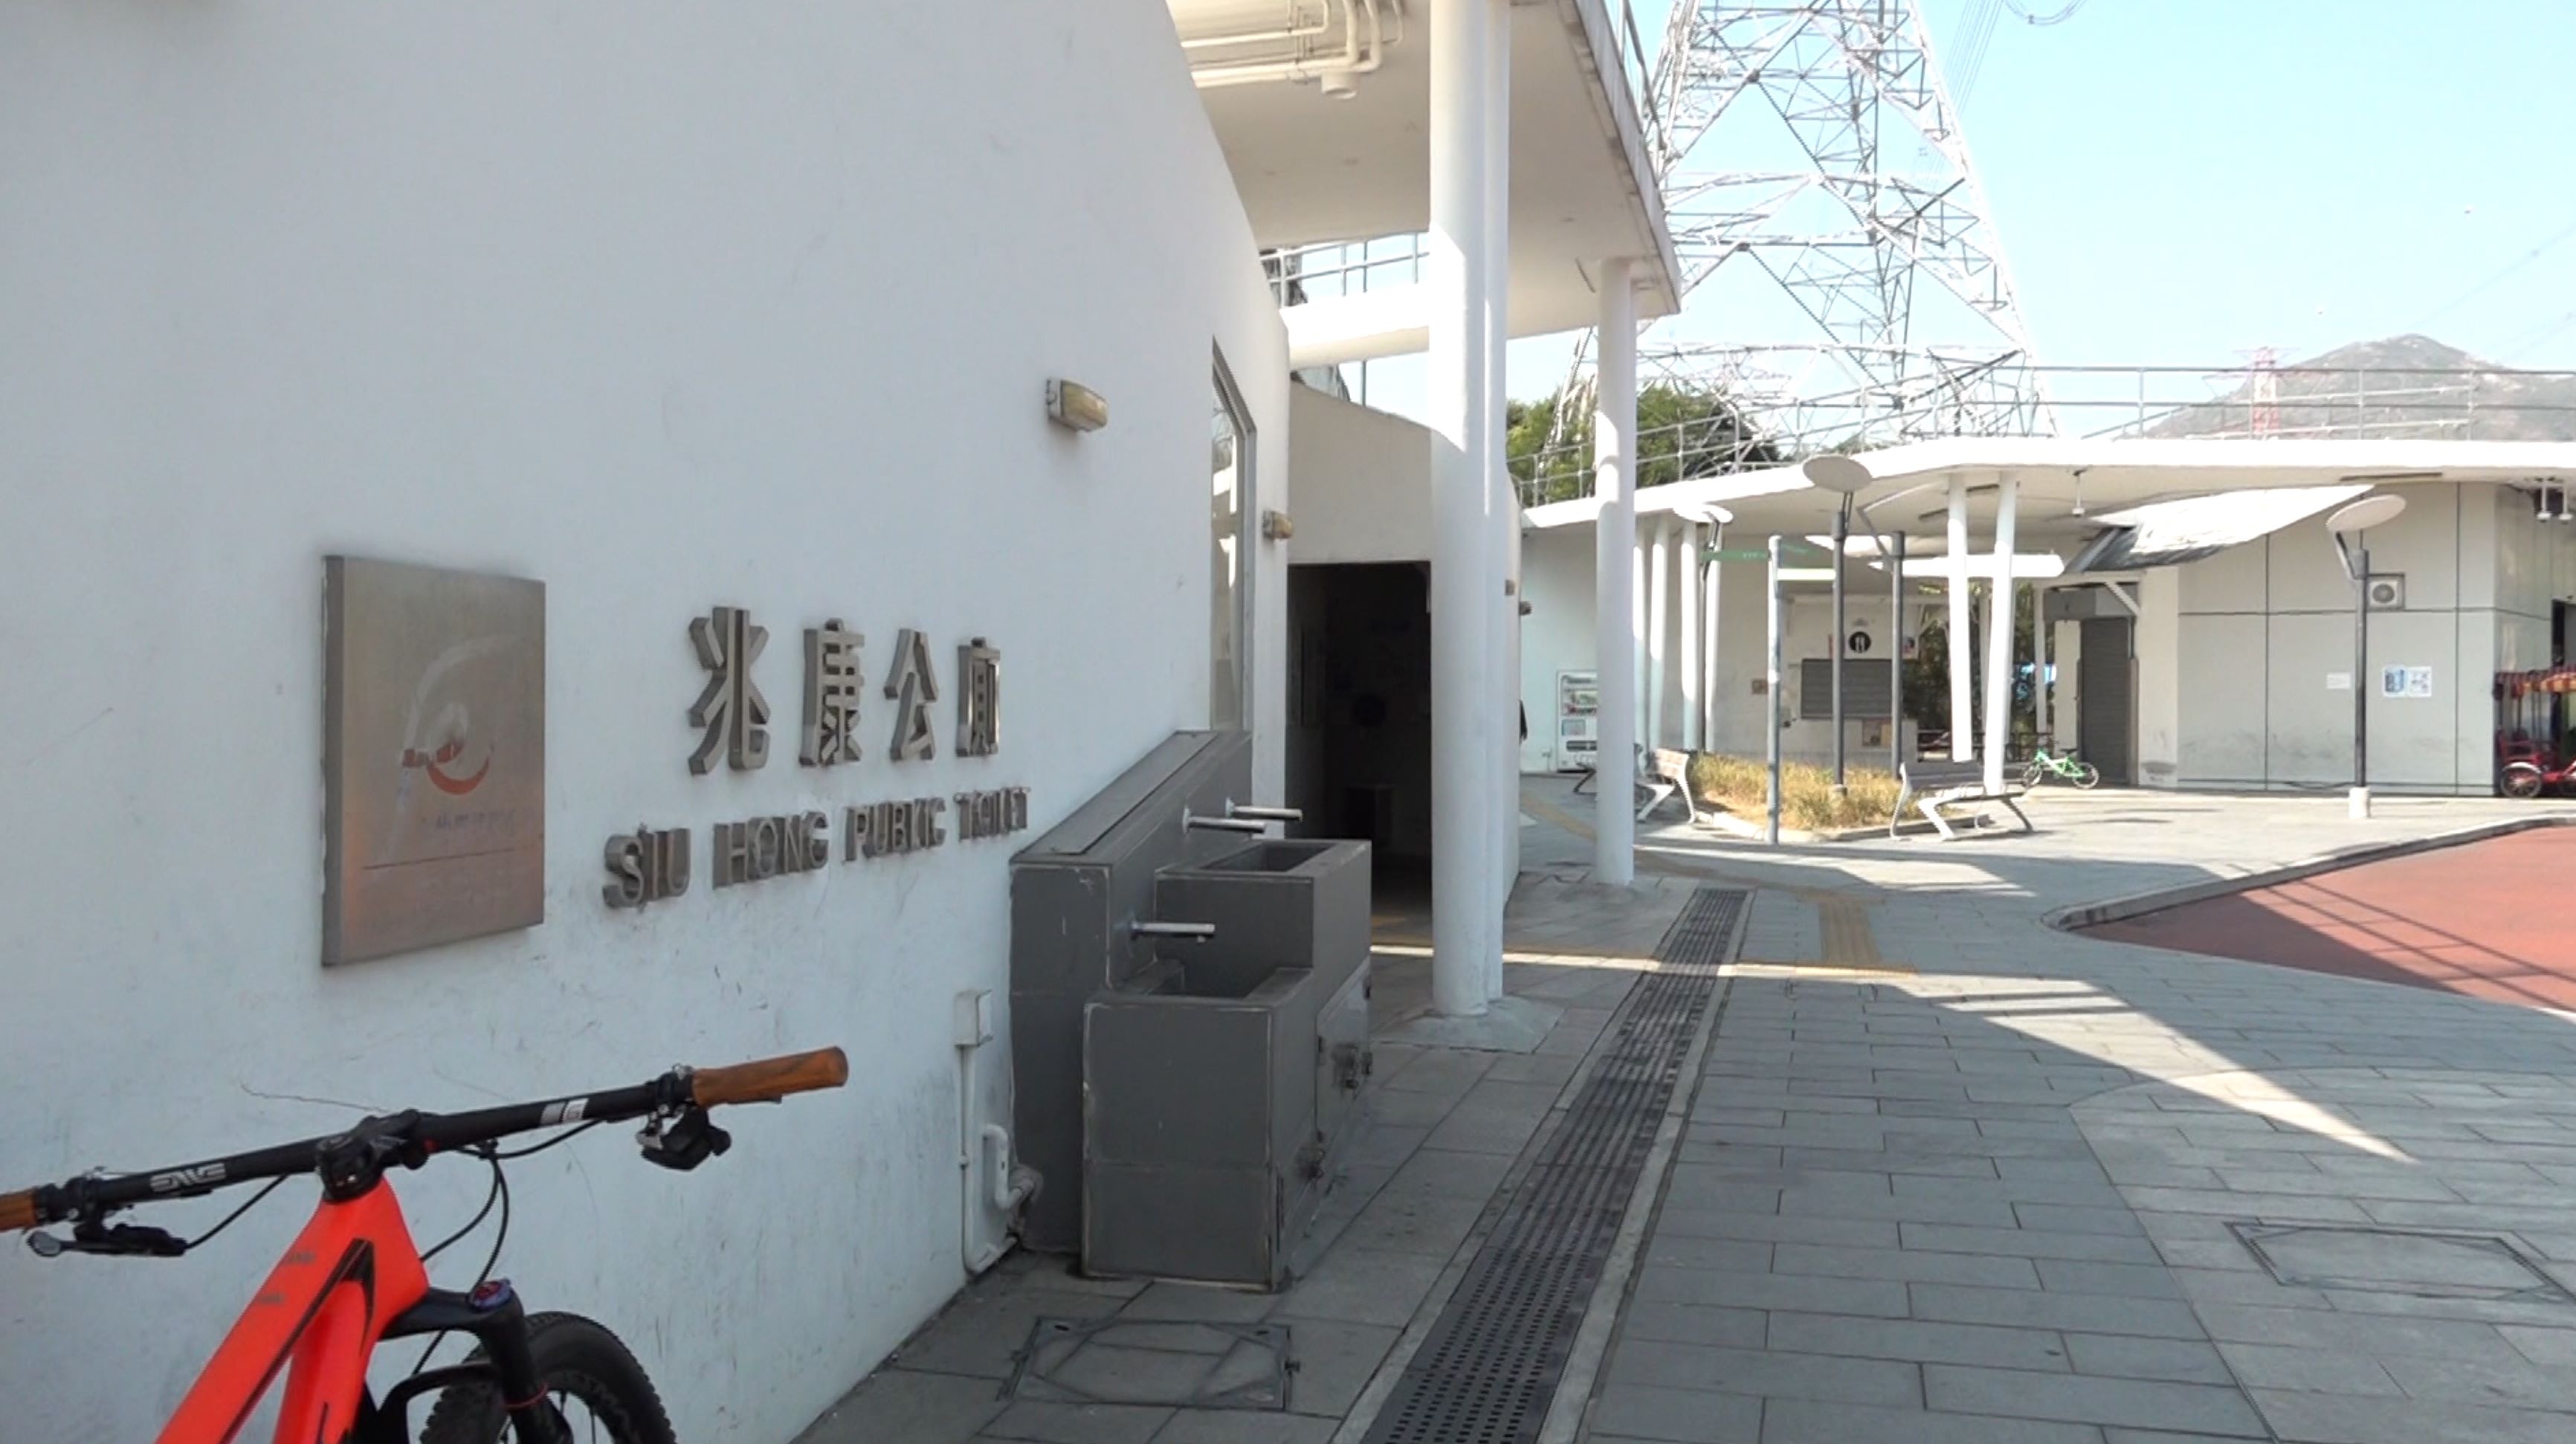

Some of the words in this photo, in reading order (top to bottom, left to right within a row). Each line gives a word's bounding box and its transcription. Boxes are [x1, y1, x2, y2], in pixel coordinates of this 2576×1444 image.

[602, 826, 691, 909] SIU
[712, 810, 829, 890] HONG
[843, 796, 946, 863] PUBLIC
